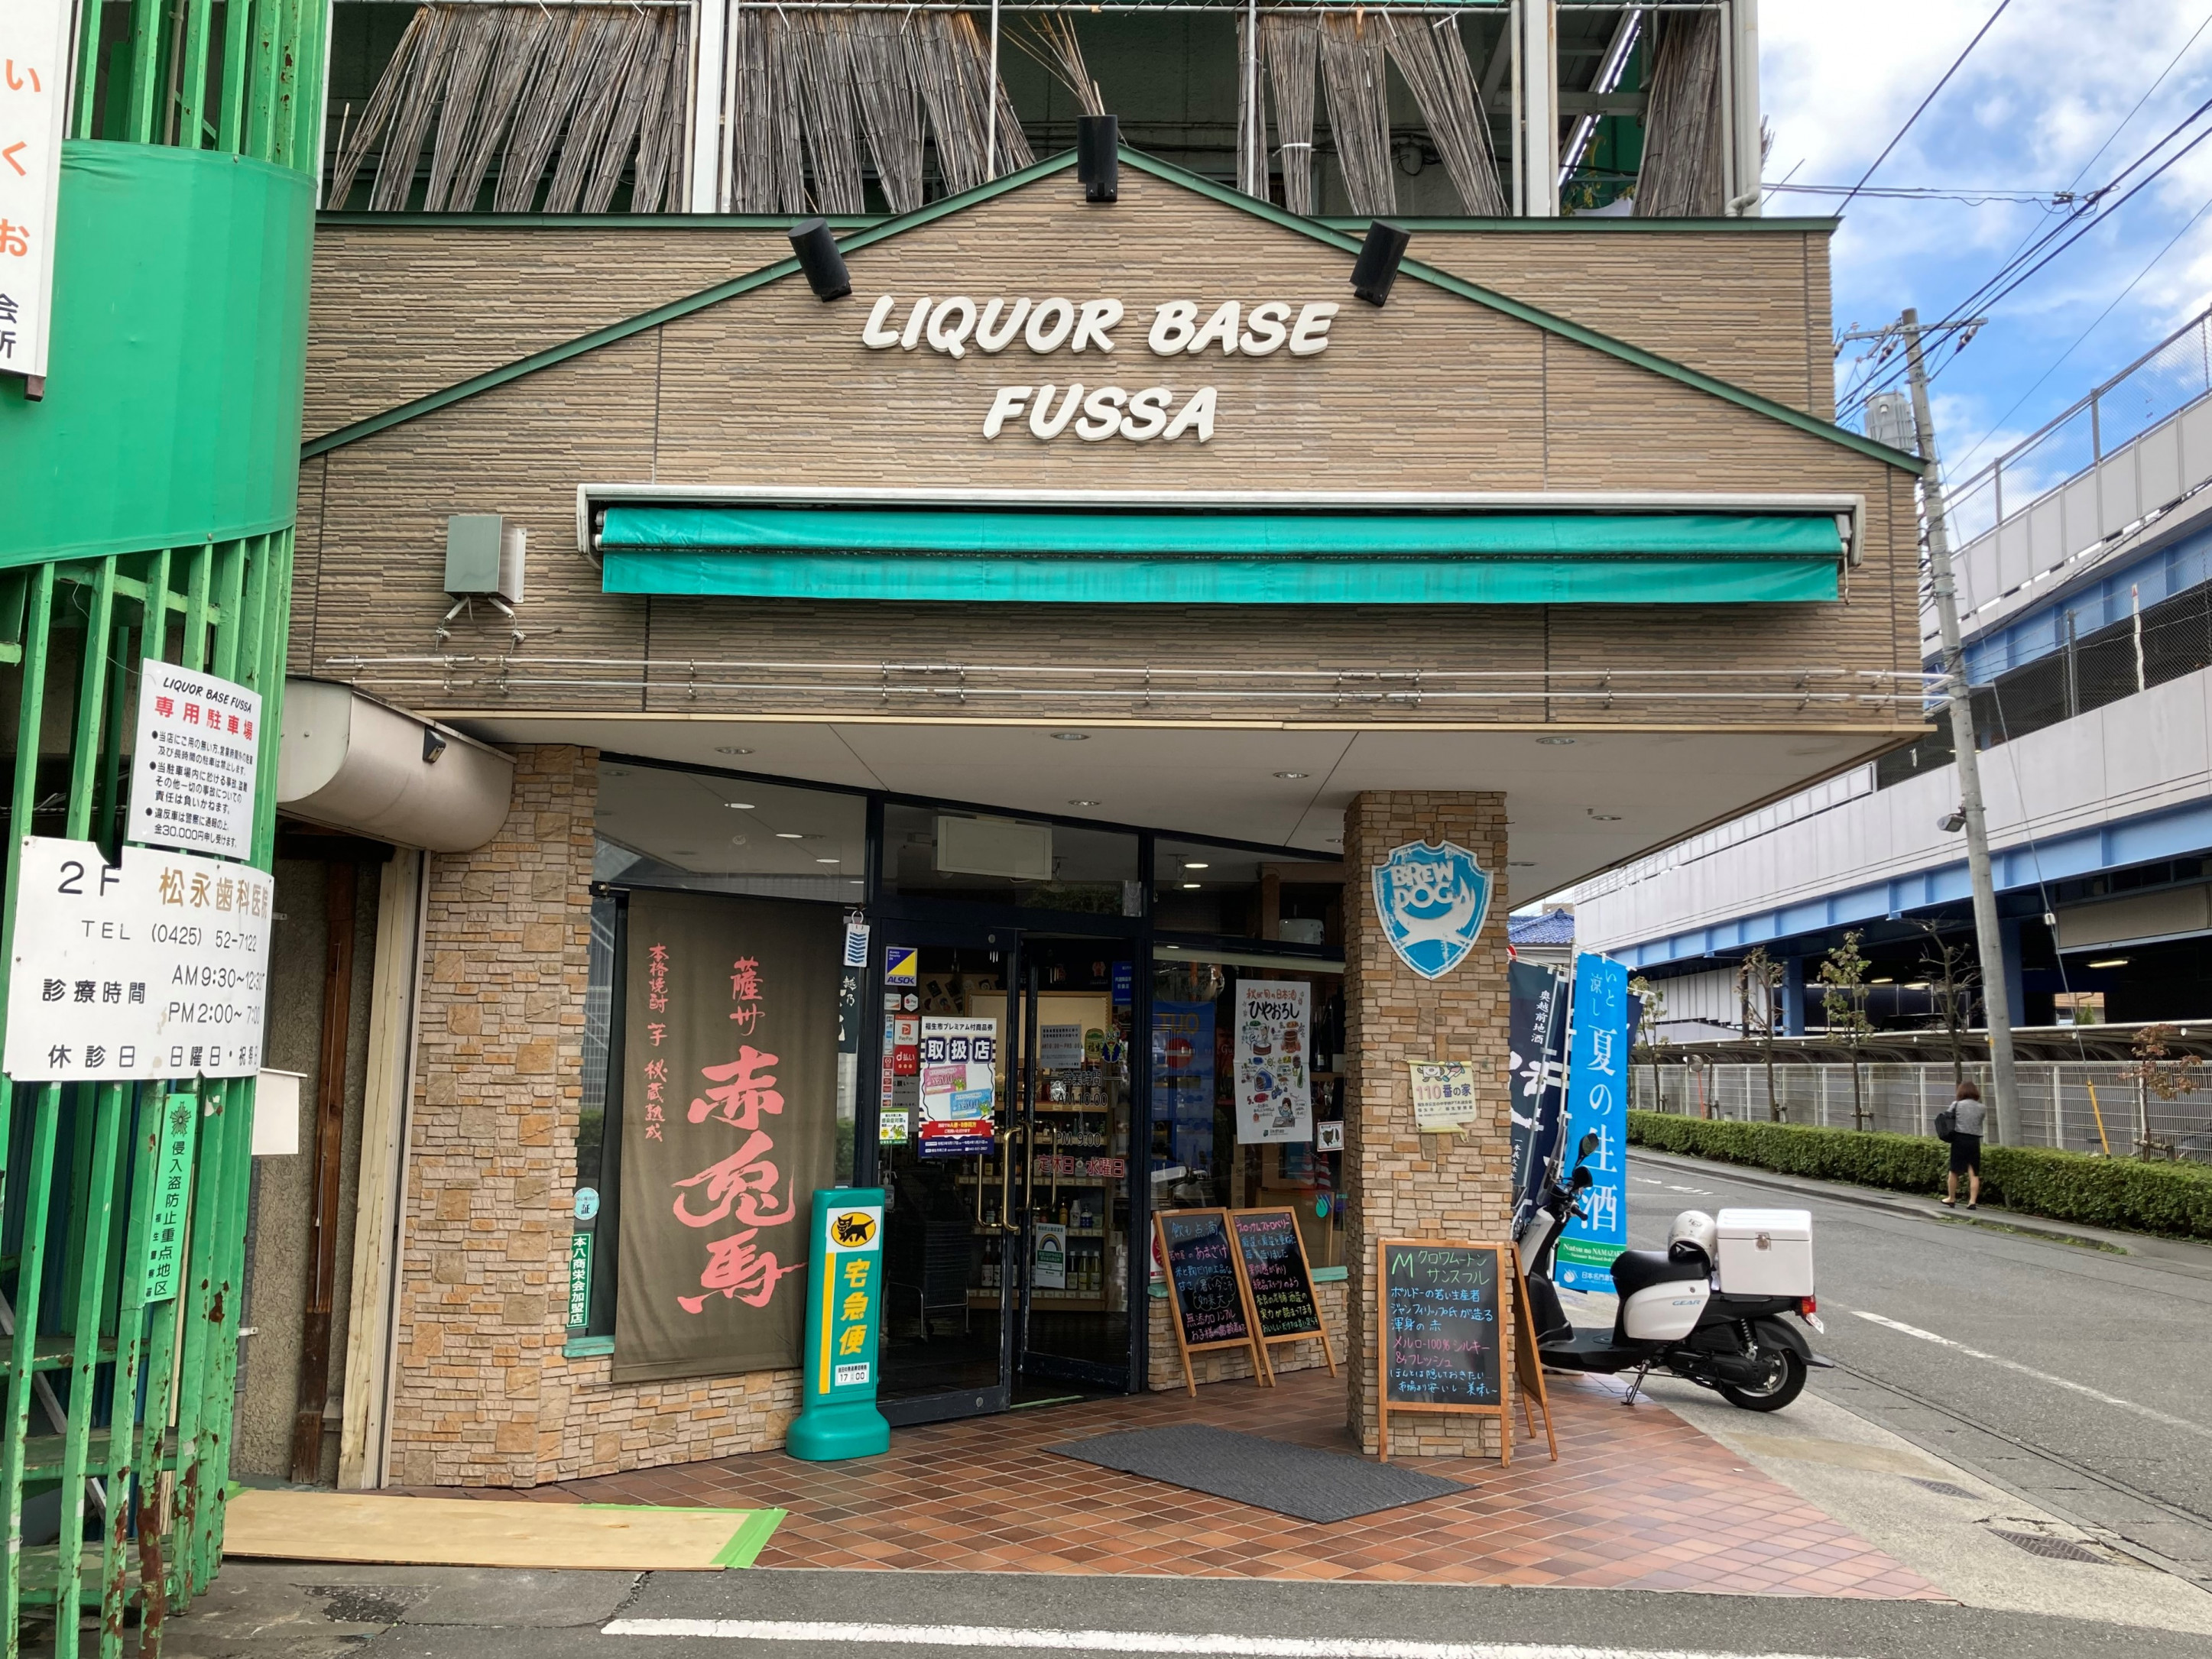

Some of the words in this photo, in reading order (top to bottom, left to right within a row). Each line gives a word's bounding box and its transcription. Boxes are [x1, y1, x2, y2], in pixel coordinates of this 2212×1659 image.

[862, 295, 1124, 360] LIQUOR
[1147, 299, 1340, 358] BASE
[983, 382, 1218, 443] FUSSA
[163, 677, 203, 696] LIQUOR
[206, 689, 229, 705] BASE
[230, 697, 252, 714] FUSSA
[154, 696, 253, 741] 専用駐車場
[1390, 860, 1454, 886] BREW
[58, 861, 121, 897] 2F
[159, 867, 268, 919] 松永歯科医院
[1393, 883, 1453, 909] DOG
[81, 920, 131, 940] TEL
[152, 923, 203, 947] (0425)
[216, 930, 257, 952] 52-7122
[42, 979, 146, 1004] 診療時間
[887, 976, 915, 984] ALSOK
[1247, 1000, 1300, 1021] ひやおろし
[1530, 990, 1551, 1045] 奥越前地酒
[47, 1044, 136, 1068] 休診日
[927, 1039, 991, 1060] 取扱店
[1062, 1071, 1101, 1086] 営業時間
[1416, 1083, 1472, 1100] 110番の家
[1077, 1132, 1101, 1147] 9:00
[1581, 1024, 1618, 1233] 夏の生酒
[1037, 1154, 1075, 1175] 定休日
[1086, 1157, 1125, 1178] 水曜日
[154, 1141, 185, 1296] 侵入盗防止重点地区
[1563, 1243, 1583, 1253] Natsu
[1392, 1252, 1413, 1278] M
[570, 1236, 587, 1324] 本八商栄会加盟店
[839, 1258, 871, 1356] 宅急便
